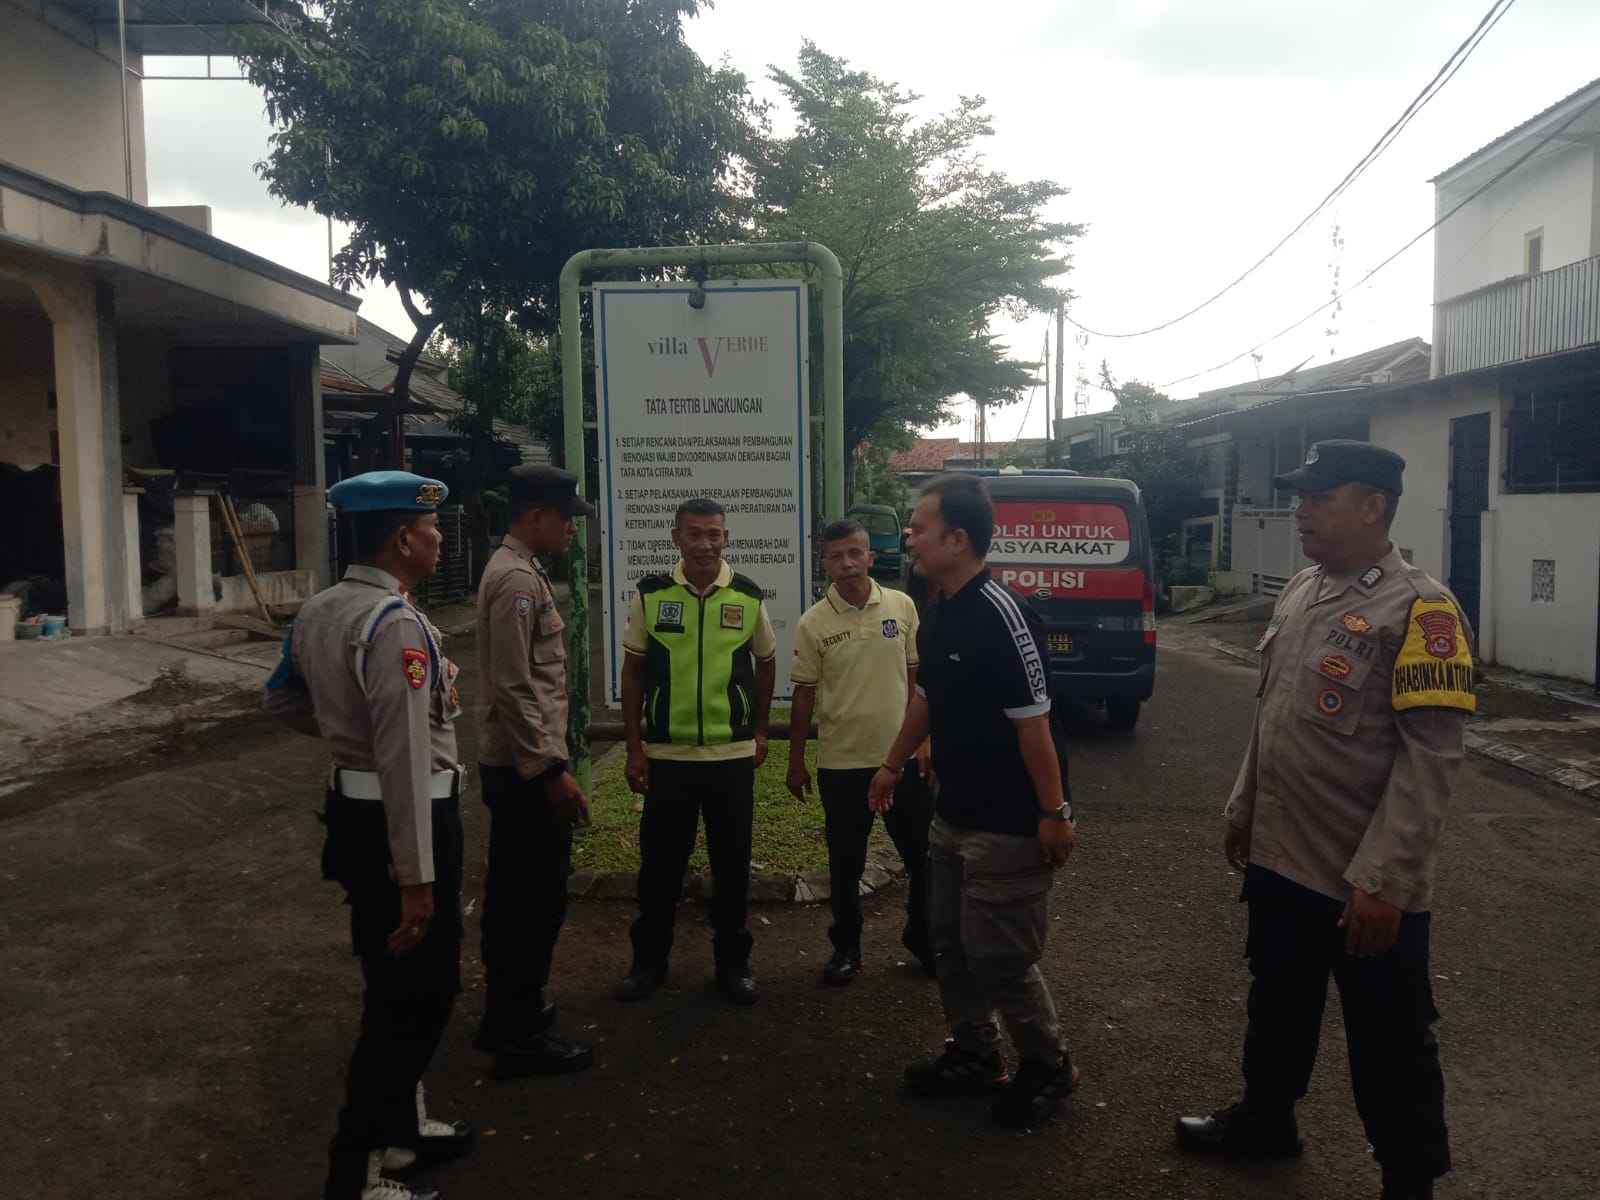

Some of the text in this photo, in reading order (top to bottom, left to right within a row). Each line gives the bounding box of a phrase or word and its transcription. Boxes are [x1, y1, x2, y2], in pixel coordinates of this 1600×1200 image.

[647, 337, 688, 355] villa
[645, 397, 763, 414] TATA TERTIB LINGKUNGAN
[622, 437, 645, 448] SETIAP
[738, 451, 765, 462] DENGAN
[766, 451, 791, 462] BAGIAN
[620, 467, 635, 478] TATA
[636, 467, 653, 478] KOTA
[624, 489, 648, 499] SETIAP
[649, 488, 698, 499] PELAKSANAAN
[700, 488, 740, 498] PEKERJAAN
[741, 487, 793, 498] PEMBANGUNAN
[740, 503, 781, 513] PERATURAN
[782, 503, 797, 513] DAN
[624, 519, 665, 529] KETENTUAN
[991, 524, 1116, 539] OLRI UNTUK
[990, 541, 1116, 555] ASYARAKAT
[740, 553, 759, 564] YANG
[760, 553, 787, 564] BERADA
[787, 553, 795, 563] DI
[1002, 570, 1087, 588] POLISI
[1326, 629, 1375, 659] POLRI
[1016, 632, 1046, 698] ELLESSE
